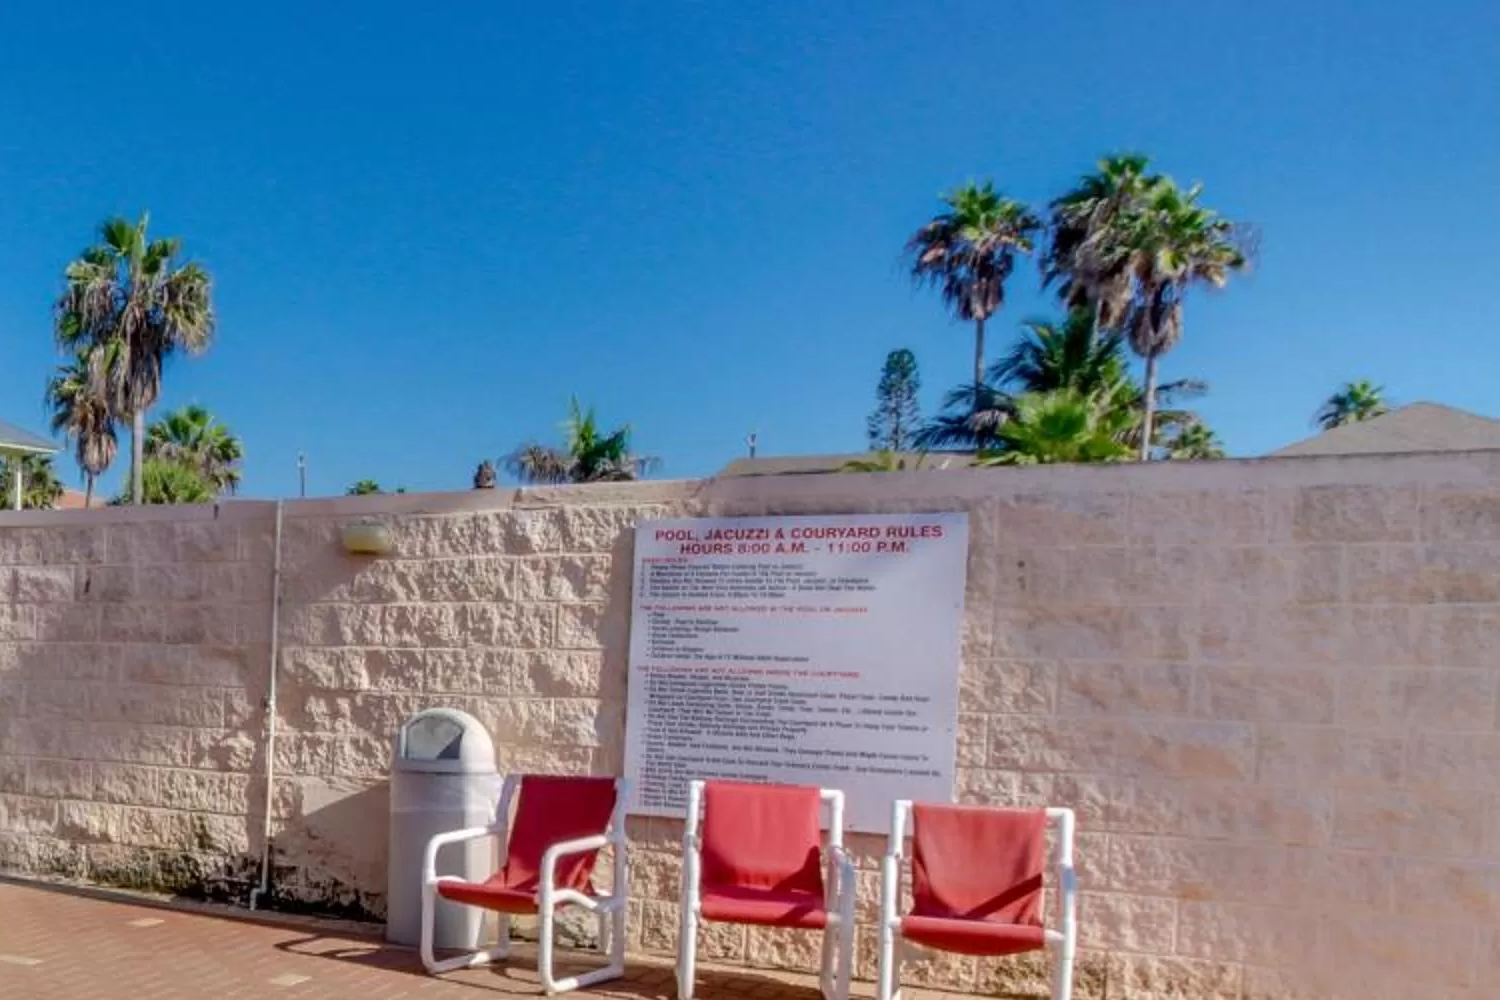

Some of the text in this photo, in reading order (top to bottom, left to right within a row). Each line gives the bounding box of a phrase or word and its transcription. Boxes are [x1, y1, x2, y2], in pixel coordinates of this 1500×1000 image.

[655, 525, 943, 542] POOL, JACUZZI & COURYARD RULES
[680, 543, 733, 554] HOURS
[775, 542, 810, 553] A.M.
[827, 542, 871, 553] 11:00
[876, 541, 910, 553] P.M.
